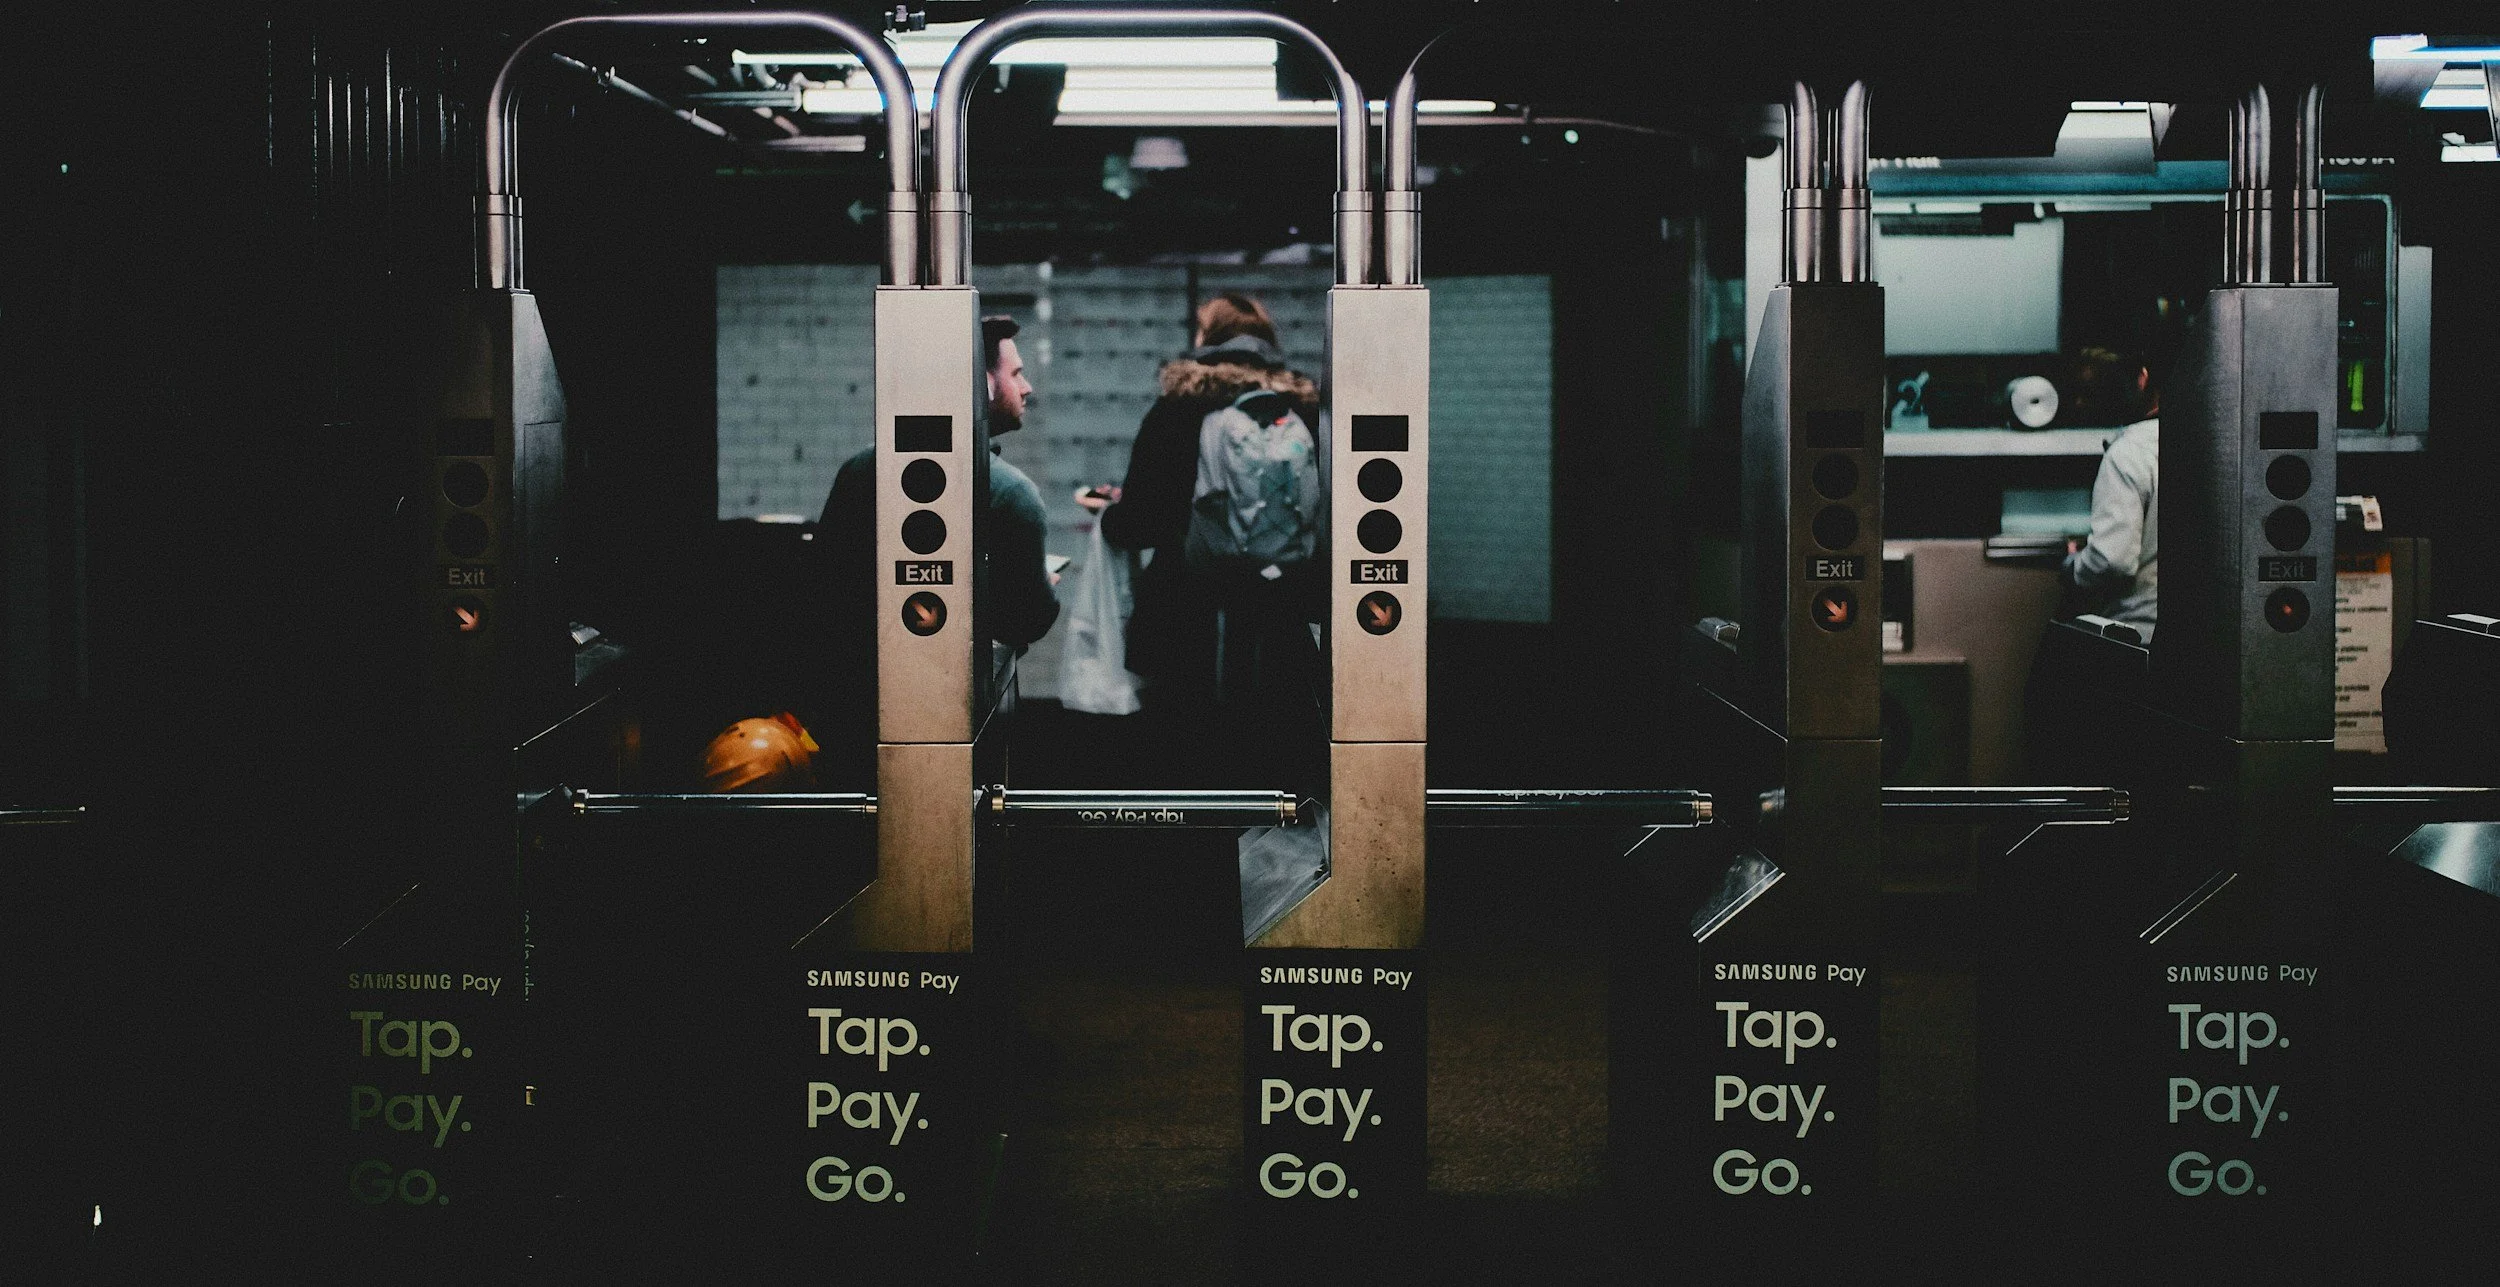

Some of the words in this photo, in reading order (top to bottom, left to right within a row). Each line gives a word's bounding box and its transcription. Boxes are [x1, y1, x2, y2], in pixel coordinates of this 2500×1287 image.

[449, 568, 485, 585] Exit
[905, 564, 942, 582] Exit
[1360, 563, 1397, 581] Exit
[1816, 560, 1853, 578] Exit
[2268, 561, 2305, 578] Exit
[1078, 810, 1107, 824] Go.
[1111, 807, 1146, 823] Pay.
[1151, 807, 1186, 823] Tap.
[349, 973, 453, 991] SAMSUNG
[462, 973, 502, 997] Pay
[807, 969, 910, 988] SAMSUNG
[920, 971, 960, 995] Pay
[1260, 966, 1363, 985] SAMSUNG
[1373, 967, 1413, 991] Pay
[1714, 963, 1817, 981] SAMSUNG
[1827, 964, 1867, 987] Pay
[2166, 965, 2269, 983] SAMSUNG
[2279, 964, 2318, 987] Pay
[350, 1011, 473, 1075] Tap.
[807, 1007, 931, 1072] Tap.
[1260, 1004, 1384, 1069] Tap.
[1714, 1001, 1837, 1065] Tap.
[2168, 1003, 2290, 1067] Tap.
[350, 1085, 472, 1148] Pay.
[807, 1082, 929, 1144] Pay.
[1260, 1078, 1382, 1140] Pay.
[1714, 1075, 1835, 1137] Pay.
[2168, 1077, 2289, 1137] Pay.
[349, 1159, 450, 1206] Go.
[806, 1155, 906, 1203] Go.
[1259, 1152, 1359, 1199] Go.
[1713, 1148, 1812, 1196] Go.
[2167, 1150, 2267, 1197] Go.
